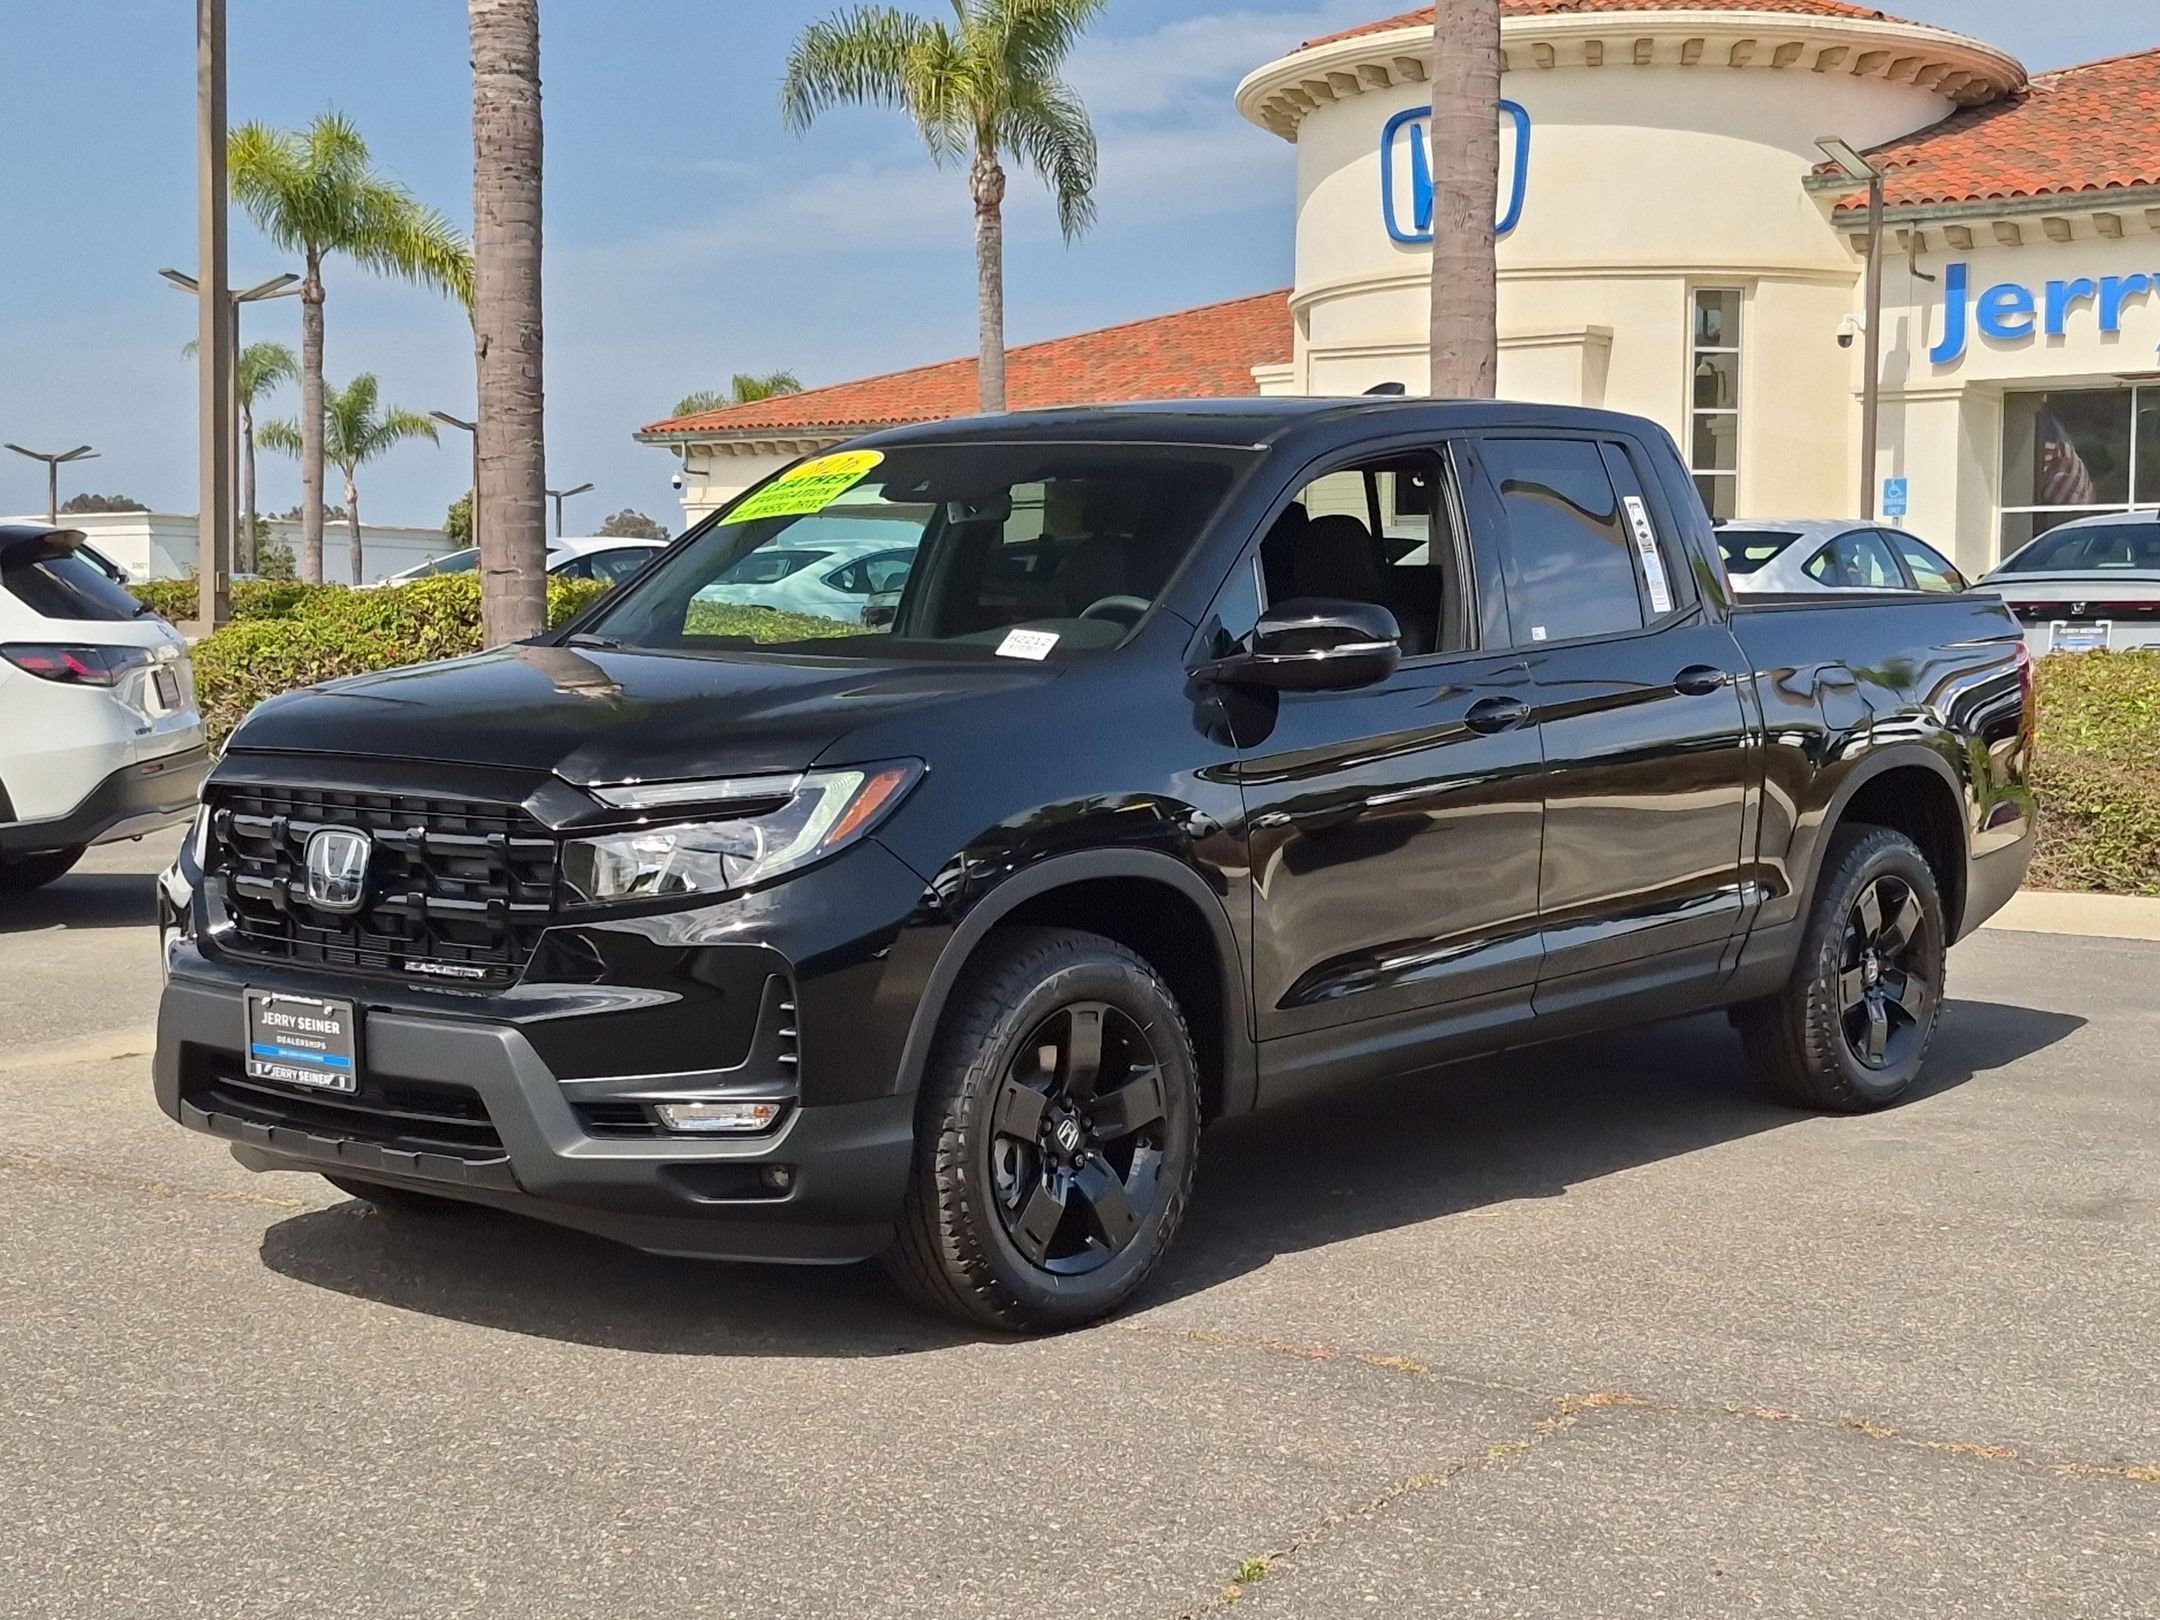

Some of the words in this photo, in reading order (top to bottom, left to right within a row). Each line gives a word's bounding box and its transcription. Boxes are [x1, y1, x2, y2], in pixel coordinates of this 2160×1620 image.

[1929, 262, 2160, 364] Jerr
[764, 471, 861, 494] LEATHER
[261, 1011, 296, 1029] JERRY
[297, 1017, 341, 1035] SEINER
[276, 1035, 327, 1050] DEALERSHIPS
[270, 1066, 297, 1081] JERRY
